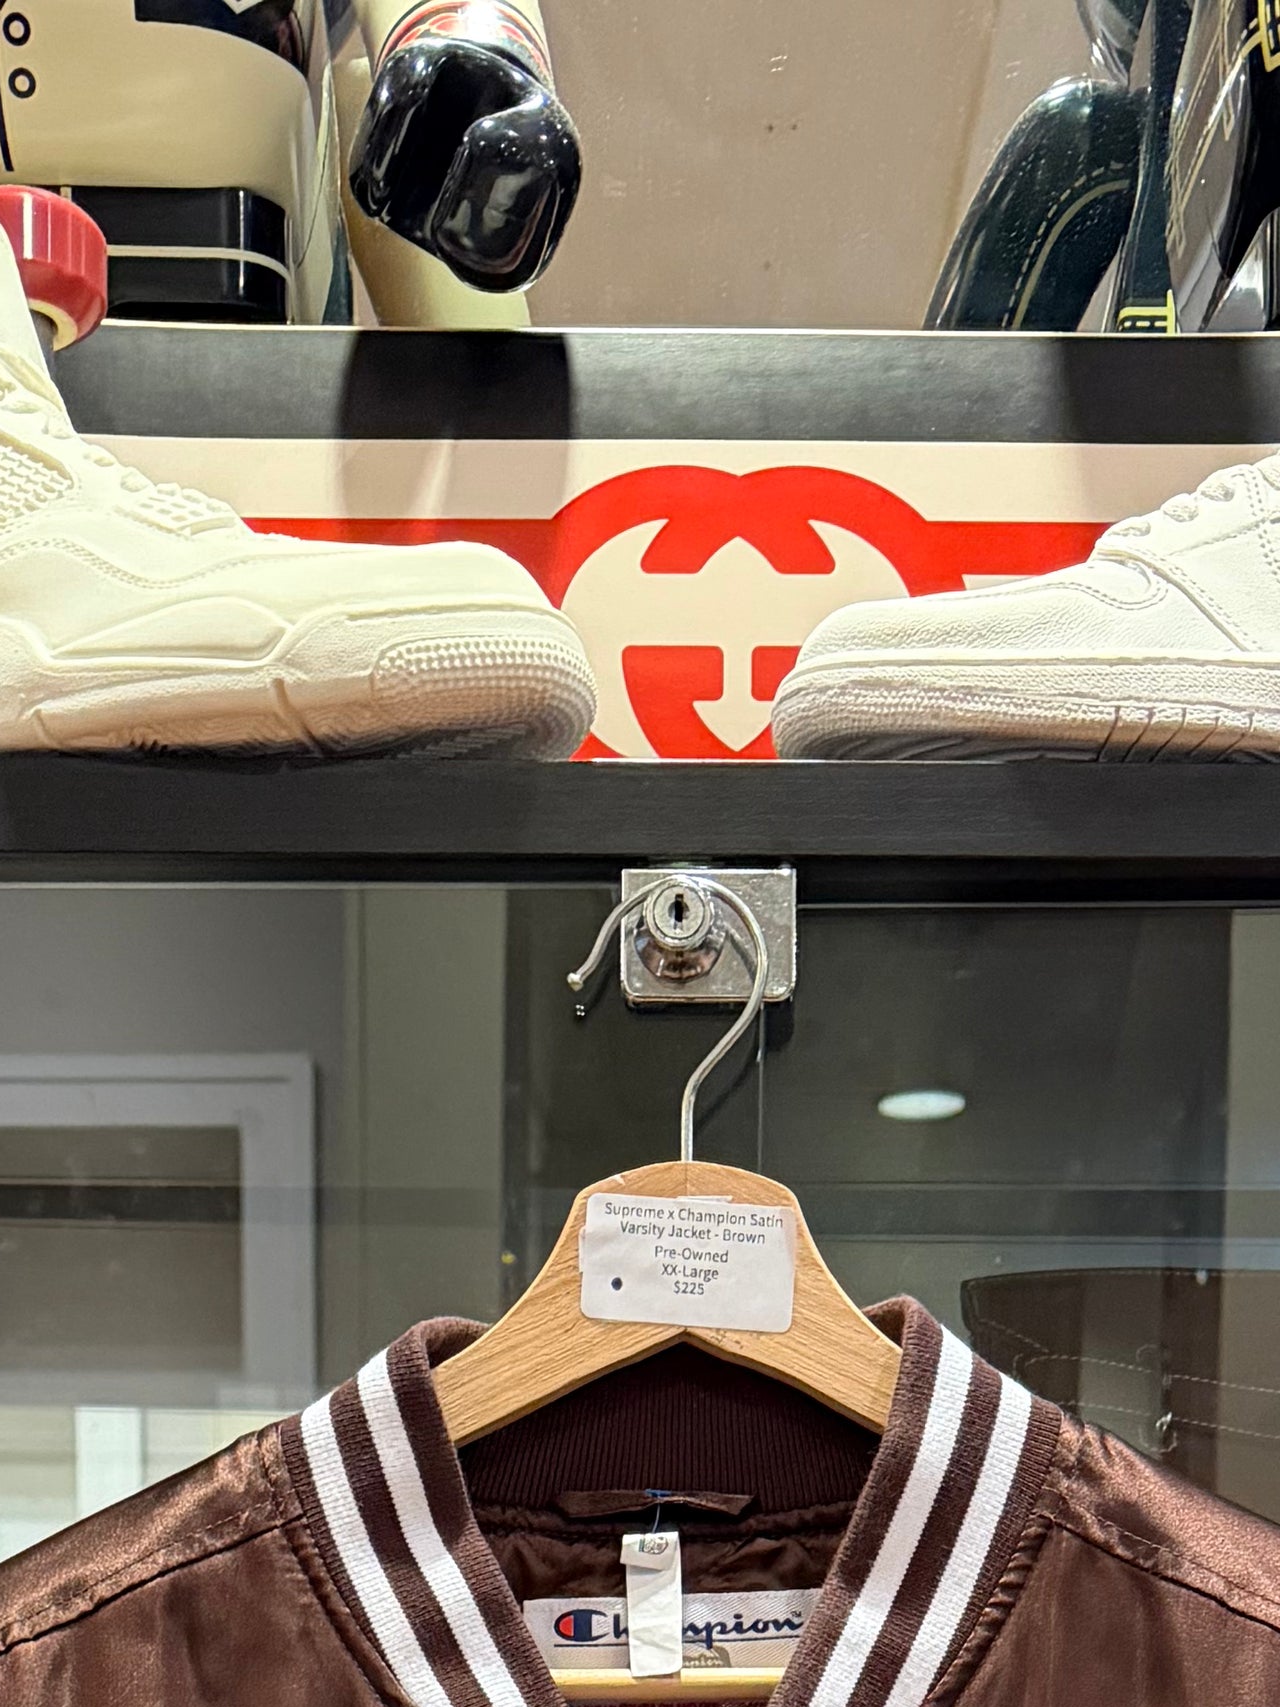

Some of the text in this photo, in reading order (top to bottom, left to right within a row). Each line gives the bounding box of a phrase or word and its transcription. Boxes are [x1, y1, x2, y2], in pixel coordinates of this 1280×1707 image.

[604, 1202, 783, 1228] Supreme x Champion Satin
[620, 1220, 665, 1240] Varsity
[668, 1224, 711, 1240] Jacket
[722, 1228, 766, 1244] Brown
[654, 1245, 729, 1263] Pre-Owned
[661, 1263, 719, 1283] XX-Large
[673, 1280, 705, 1296] $225
[554, 1609, 802, 1650] Chpion
